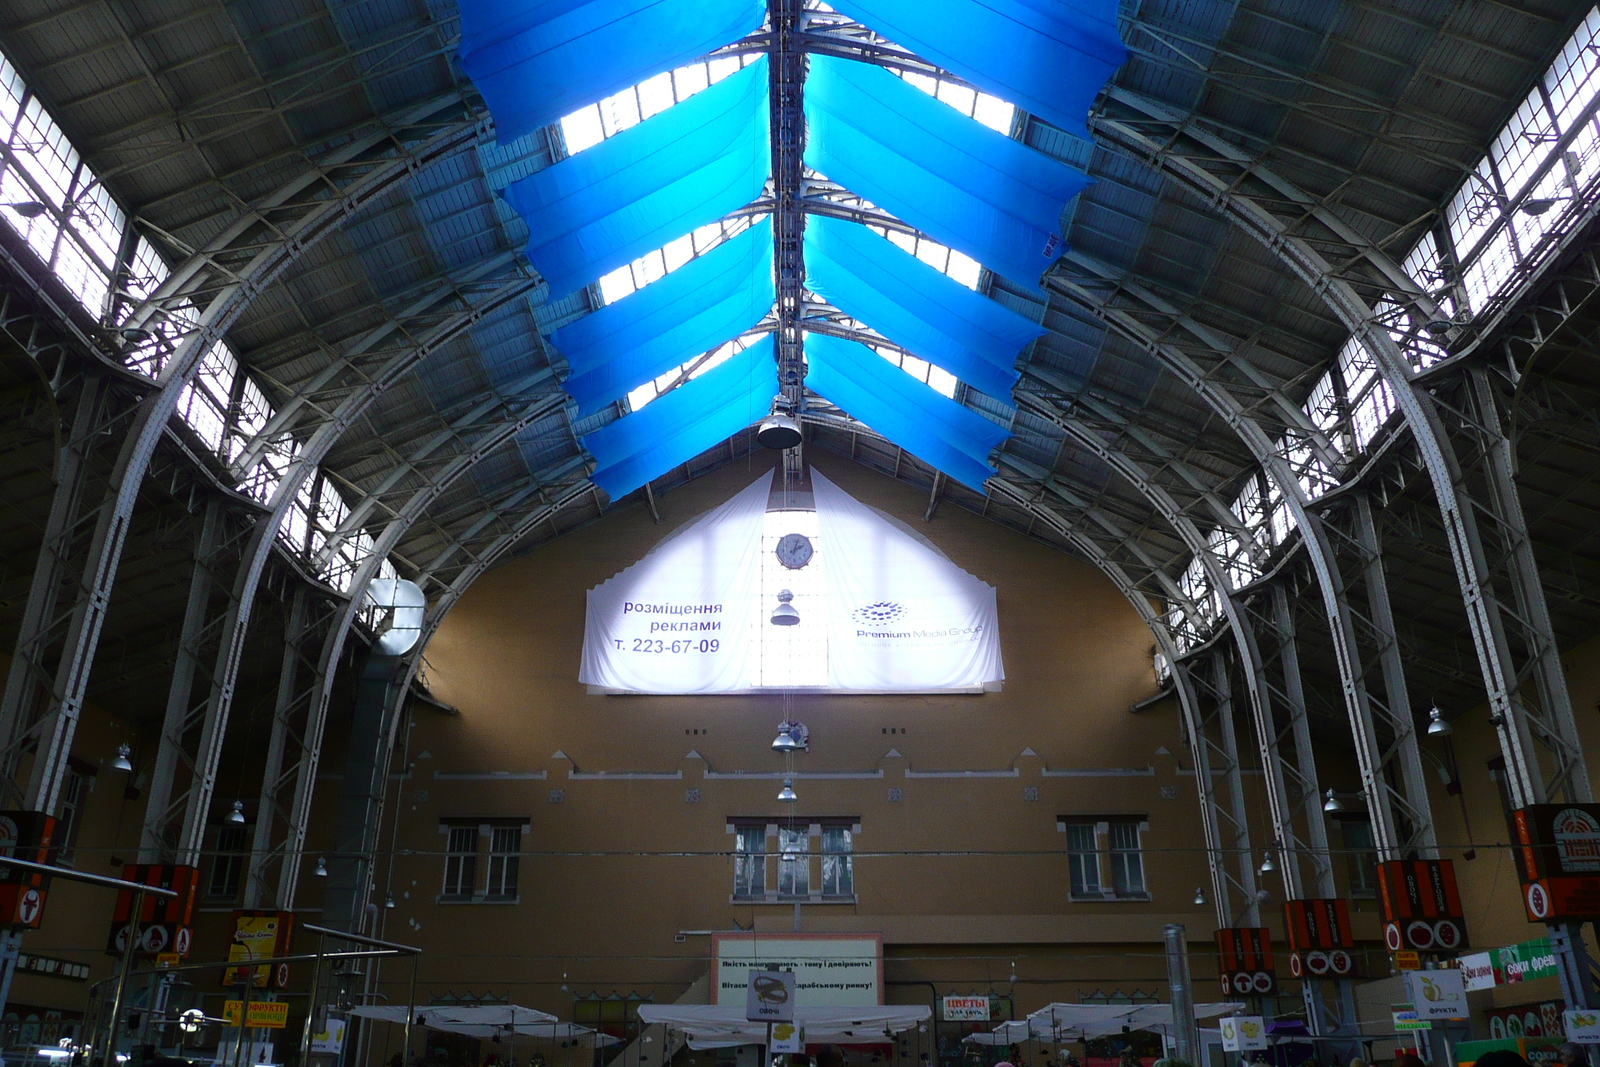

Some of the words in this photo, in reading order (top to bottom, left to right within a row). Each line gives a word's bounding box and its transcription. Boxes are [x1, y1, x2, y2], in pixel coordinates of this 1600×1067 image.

[624, 601, 722, 616] розміщення
[650, 621, 721, 633] реклами
[856, 630, 911, 638] Premium
[913, 629, 947, 638] Media
[949, 625, 983, 636] Group
[614, 639, 626, 650] т.
[632, 638, 720, 654] 223-67-09
[1406, 875, 1417, 905] ОВОЧІ
[1431, 865, 1446, 912] КАРТОПЛЯ
[1307, 912, 1316, 937] ОВОЧІ
[828, 961, 872, 969] довіряють!
[1507, 960, 1530, 975] соки
[795, 982, 844, 990] сарабському
[845, 982, 873, 990] ринку!
[947, 999, 985, 1008] ЦВЕТЫ
[1528, 1051, 1558, 1060] СОКИ
